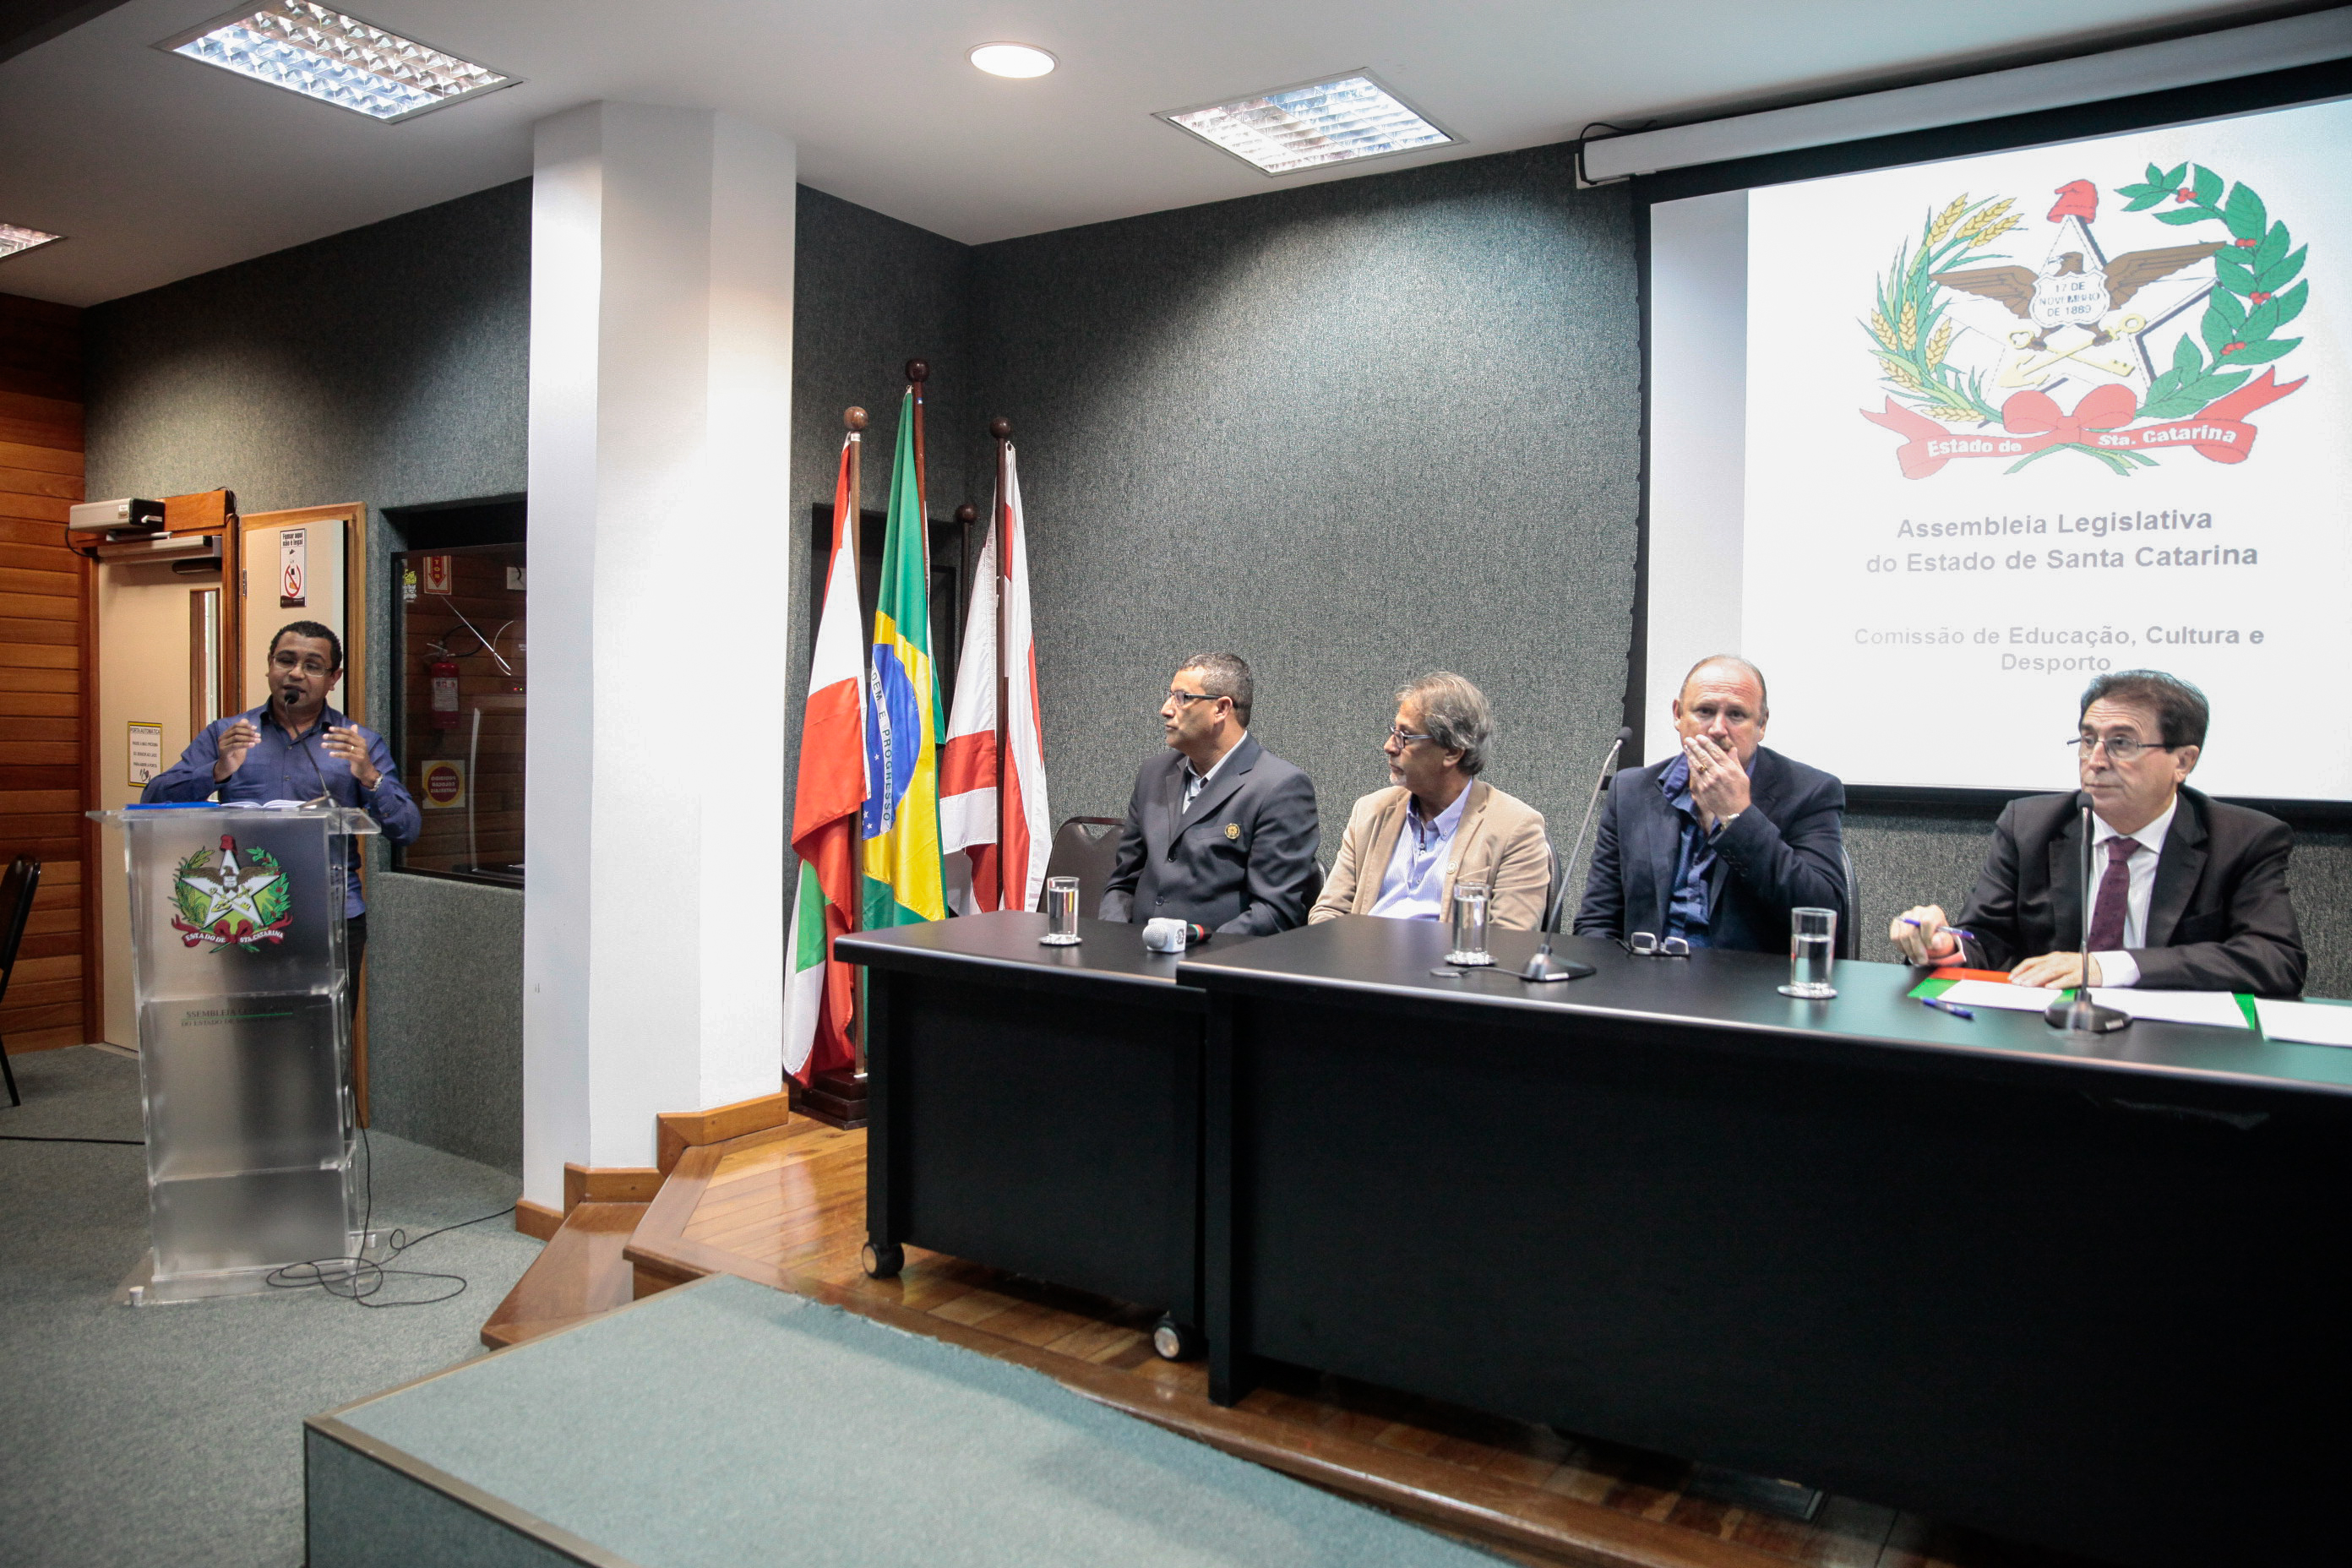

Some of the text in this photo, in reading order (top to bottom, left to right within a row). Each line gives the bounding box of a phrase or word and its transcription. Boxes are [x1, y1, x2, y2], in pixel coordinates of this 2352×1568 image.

[2071, 281, 2085, 291] DE
[2047, 304, 2092, 317] DE 1889
[1926, 424, 2237, 457] Estado de Sta. Catarina
[1897, 509, 2212, 538] Assembleia Legislativa
[1866, 544, 2258, 573] do Estado de Santa Catarina
[1854, 625, 2264, 648] Comissão de Educação, Cultura e
[2001, 652, 2111, 675] Desporto
[882, 729, 893, 821] PROGRESSO
